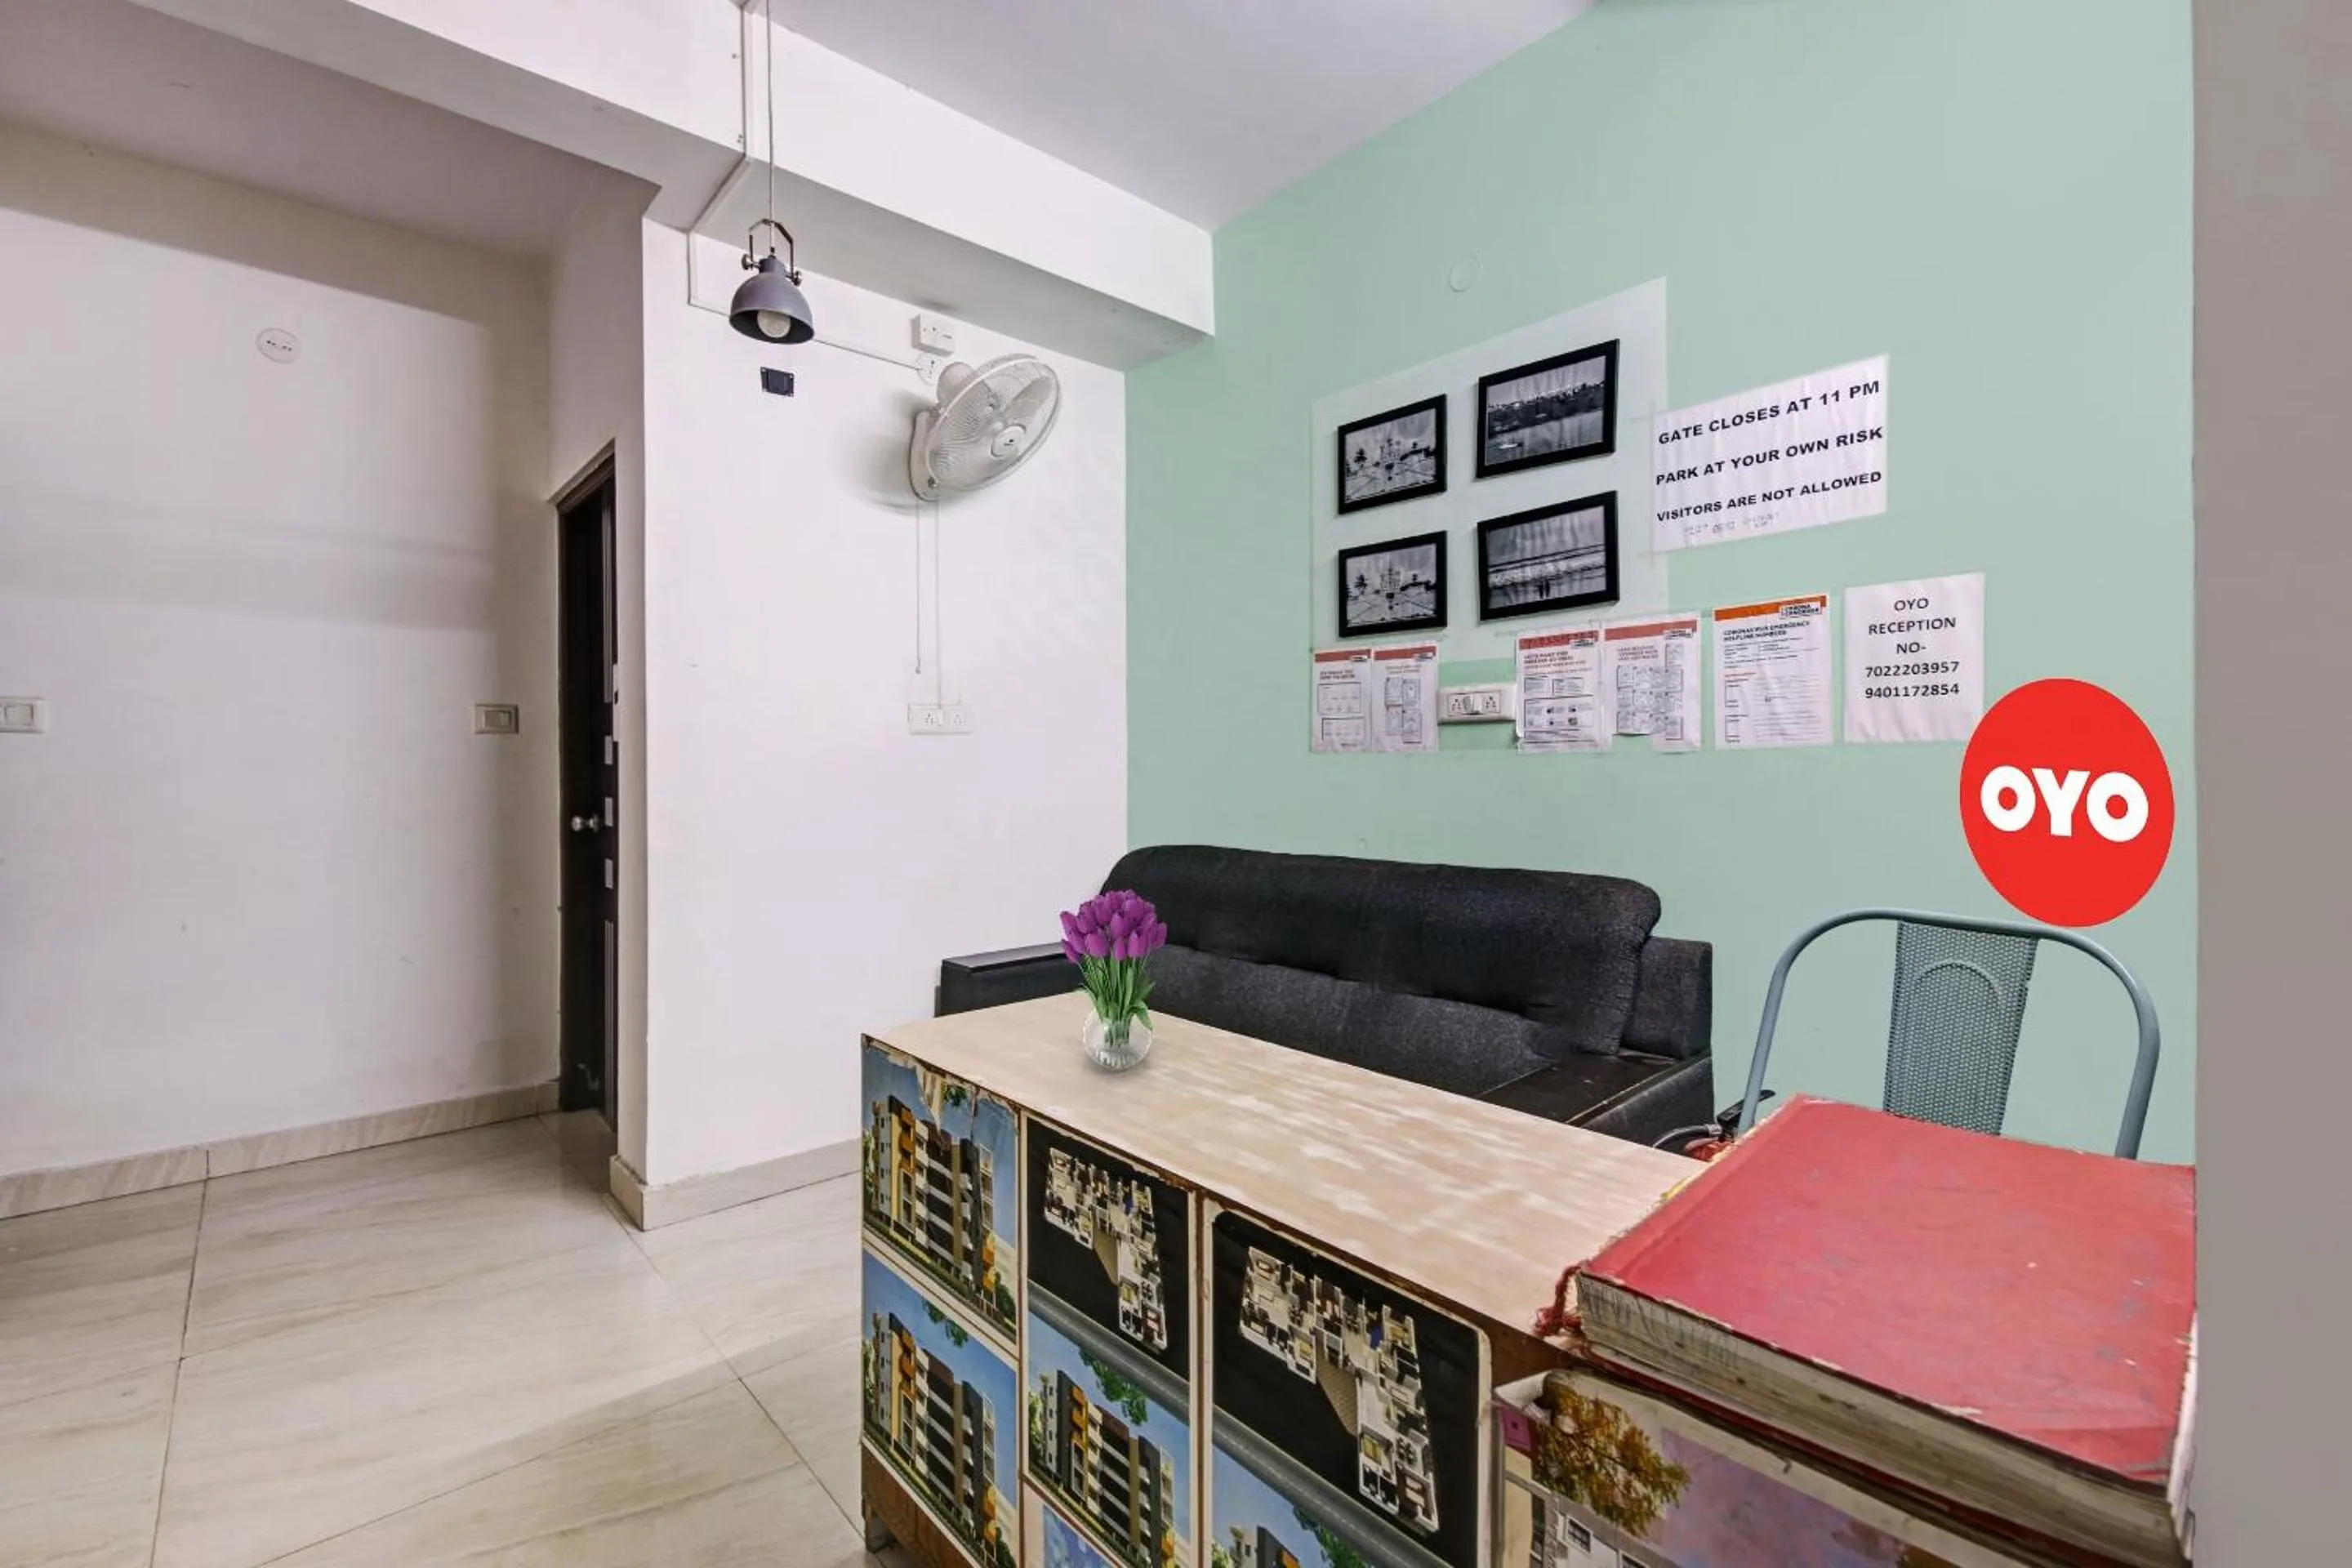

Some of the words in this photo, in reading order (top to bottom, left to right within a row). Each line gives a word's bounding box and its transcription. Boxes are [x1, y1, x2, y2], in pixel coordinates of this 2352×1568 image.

[1659, 425, 1703, 444] GATE
[1708, 405, 1780, 433] CLOSES
[1786, 398, 1812, 414] AT
[1820, 390, 1840, 405] 11
[1850, 381, 1879, 399] PM
[1656, 466, 1699, 485] PARK
[1704, 461, 1725, 475] AT
[1731, 449, 1780, 469] YOUR
[1786, 439, 1829, 457] OWN
[1835, 426, 1882, 448] RISK
[1657, 501, 1722, 522] VISITORS
[1726, 495, 1757, 509] ARE
[1762, 488, 1794, 502] NOT
[1800, 471, 1882, 496] ALLOWED
[1894, 598, 1929, 611] OYO
[1869, 617, 1956, 635] RECEPTION
[1895, 642, 1927, 654] NO-
[1865, 662, 1960, 678] 7022203957
[1865, 684, 1960, 699] 9401172854
[1980, 765, 2149, 842] OYO
